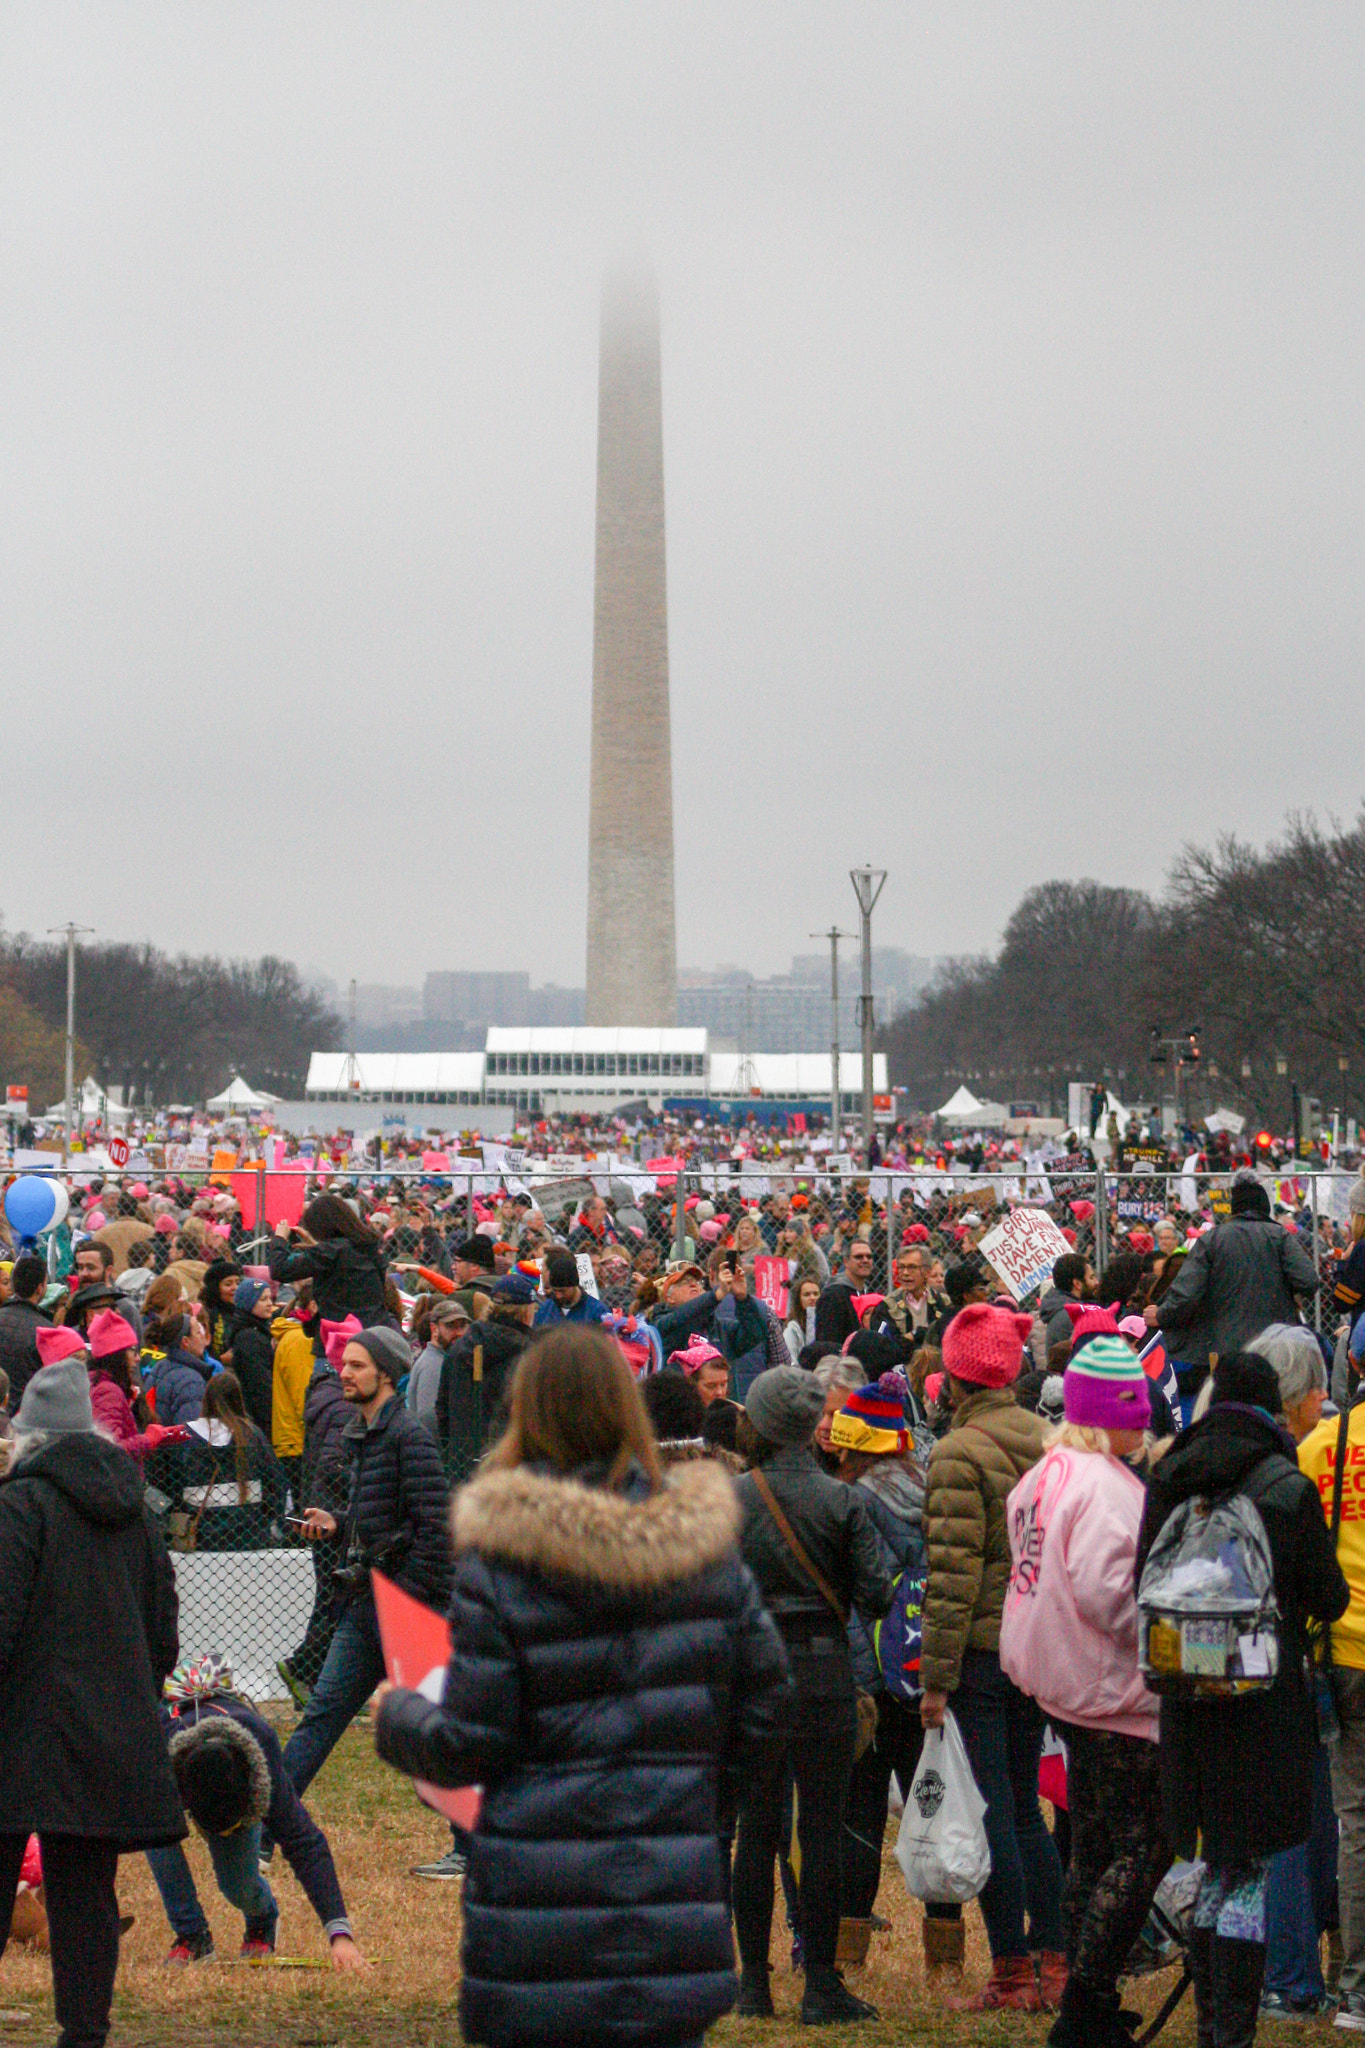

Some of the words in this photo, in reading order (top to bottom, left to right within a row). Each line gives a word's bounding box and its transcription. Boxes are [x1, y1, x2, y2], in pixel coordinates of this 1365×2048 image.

[110, 1141, 126, 1163] NO
[1123, 1153, 1136, 1162] HE
[1139, 1155, 1163, 1164] WILL
[1002, 1208, 1038, 1234] GIRLS
[1117, 1201, 1142, 1216] BURY
[988, 1233, 1018, 1262] JUST
[1000, 1237, 1037, 1271] HAVE
[1017, 1262, 1052, 1295] HUMAN
